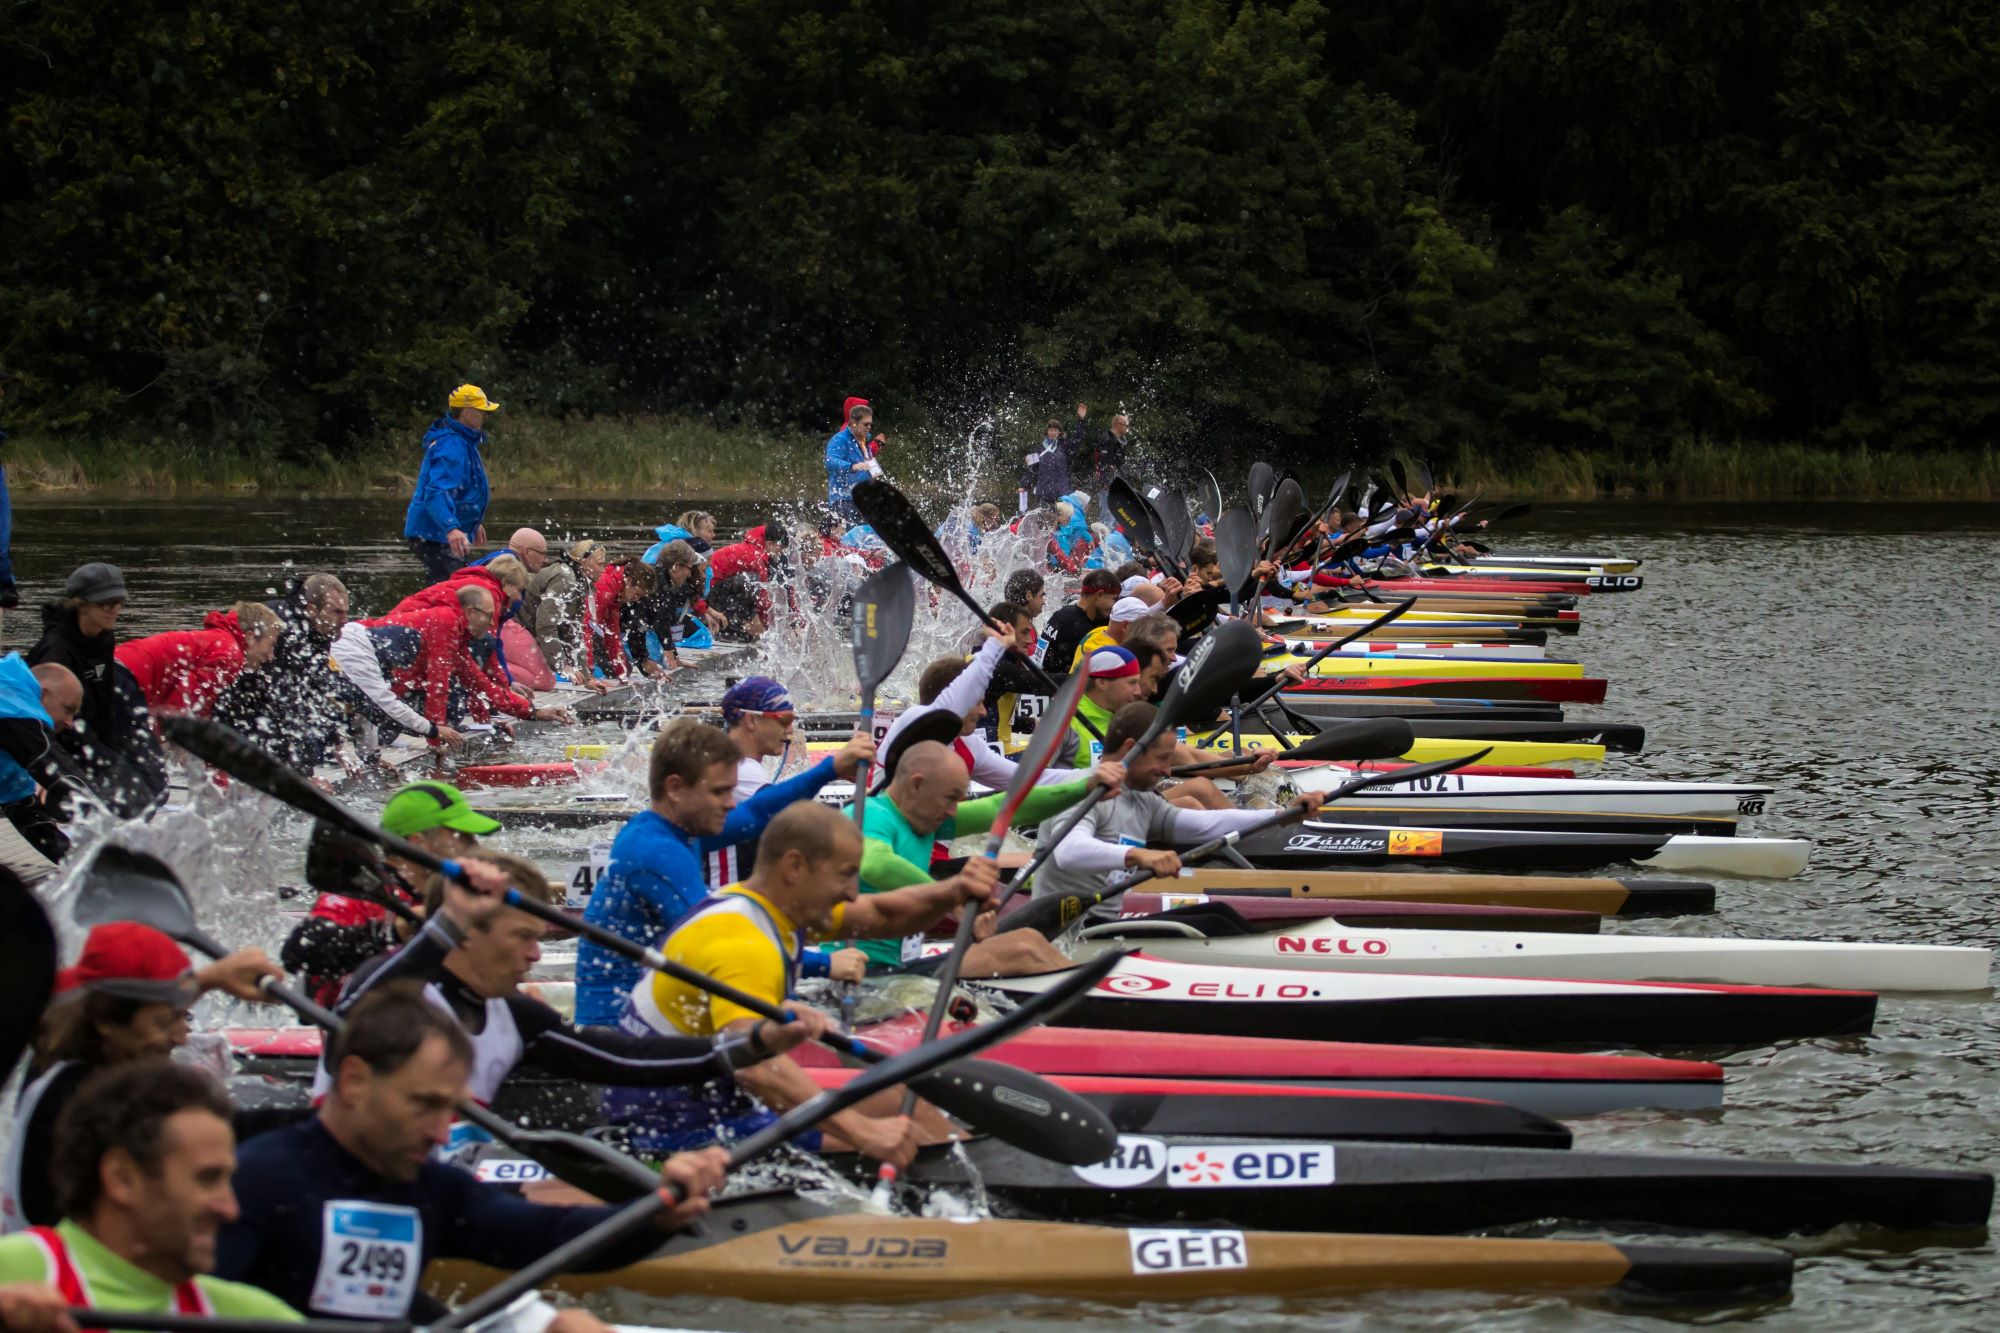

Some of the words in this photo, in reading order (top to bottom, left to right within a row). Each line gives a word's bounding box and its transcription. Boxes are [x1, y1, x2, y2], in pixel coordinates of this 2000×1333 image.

[1585, 576, 1639, 587] ELIO
[1278, 936, 1388, 955] NELO
[1188, 983, 1309, 999] ELIO
[1098, 1144, 1155, 1170] RA
[1232, 1152, 1320, 1180] eDF
[337, 1241, 406, 1283] 2499
[1136, 1236, 1243, 1269] GER
